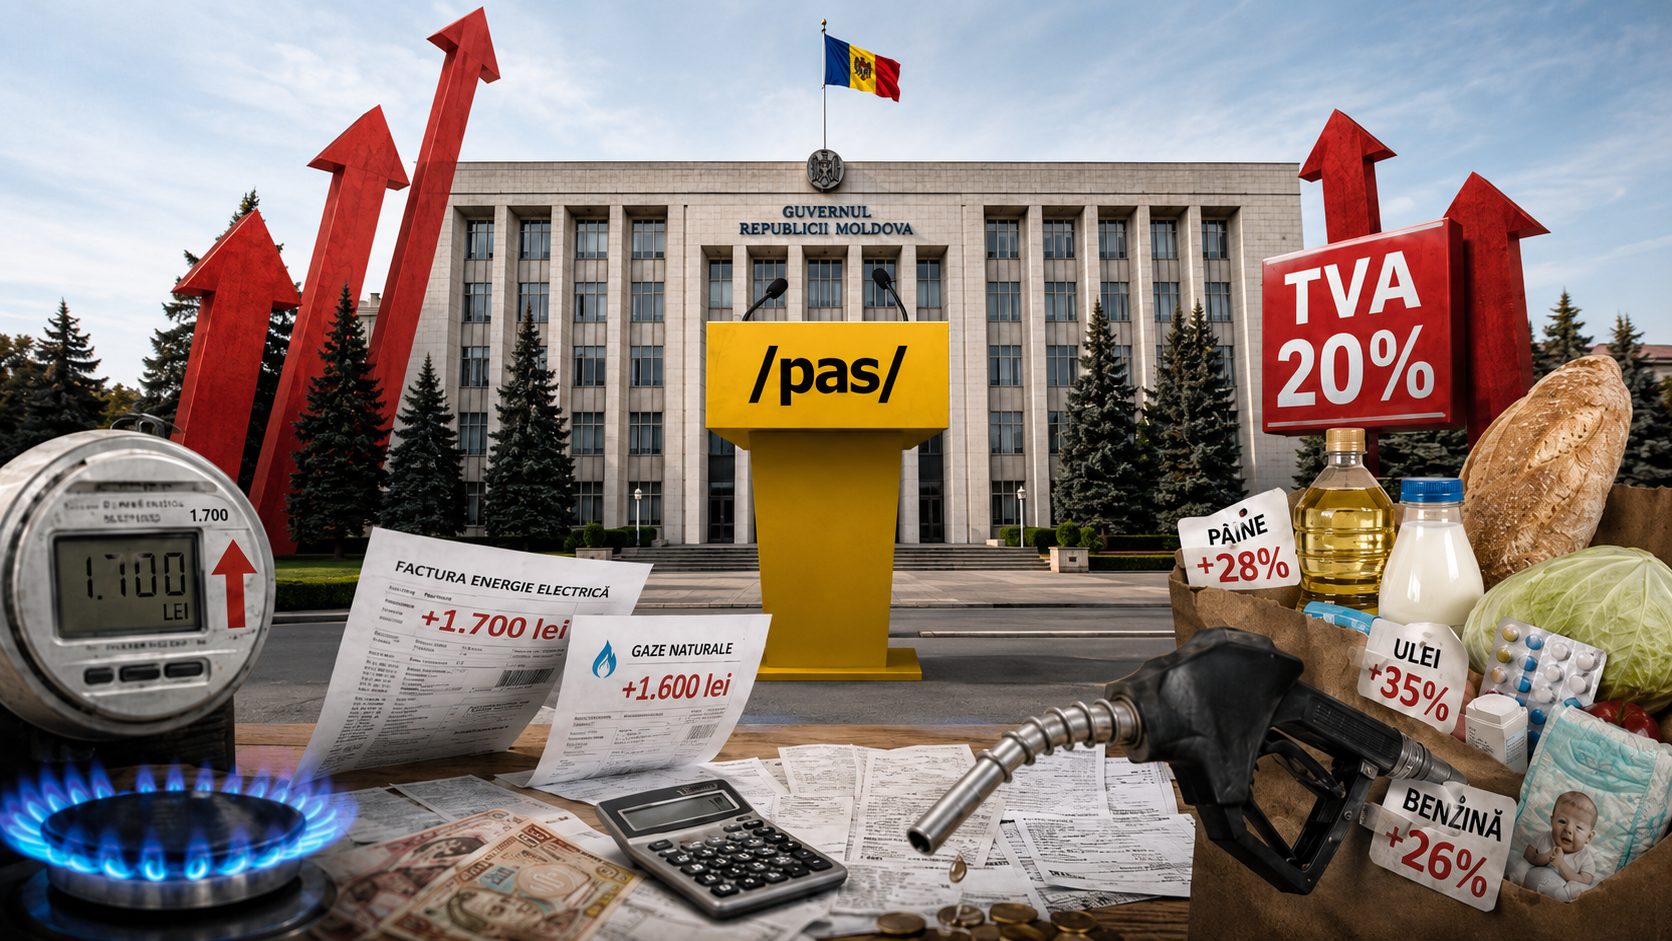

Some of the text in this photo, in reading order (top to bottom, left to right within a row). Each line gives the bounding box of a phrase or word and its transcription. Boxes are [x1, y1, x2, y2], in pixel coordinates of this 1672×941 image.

[739, 222, 914, 236] REPUBLICII MOLDOVA
[783, 205, 872, 219] GUVERNUL
[1284, 250, 1422, 326] TVA
[749, 345, 908, 406] /pas/
[1277, 324, 1435, 408] 20%
[190, 508, 229, 522] 1.700
[86, 551, 186, 601] 1.700
[395, 560, 467, 585] FACTURA
[470, 575, 534, 595] ENERGIE
[537, 584, 610, 600] ELECTRICĂ
[1197, 546, 1290, 583] +28%
[163, 603, 189, 621] LEI
[421, 609, 527, 639] +1.700
[532, 617, 570, 641] lei
[631, 642, 734, 659] GAZE NATURALE
[1393, 638, 1441, 669] ULEI
[622, 672, 732, 702] +1.600 lei
[1368, 663, 1449, 723] +35%
[1385, 826, 1487, 898] +26%
